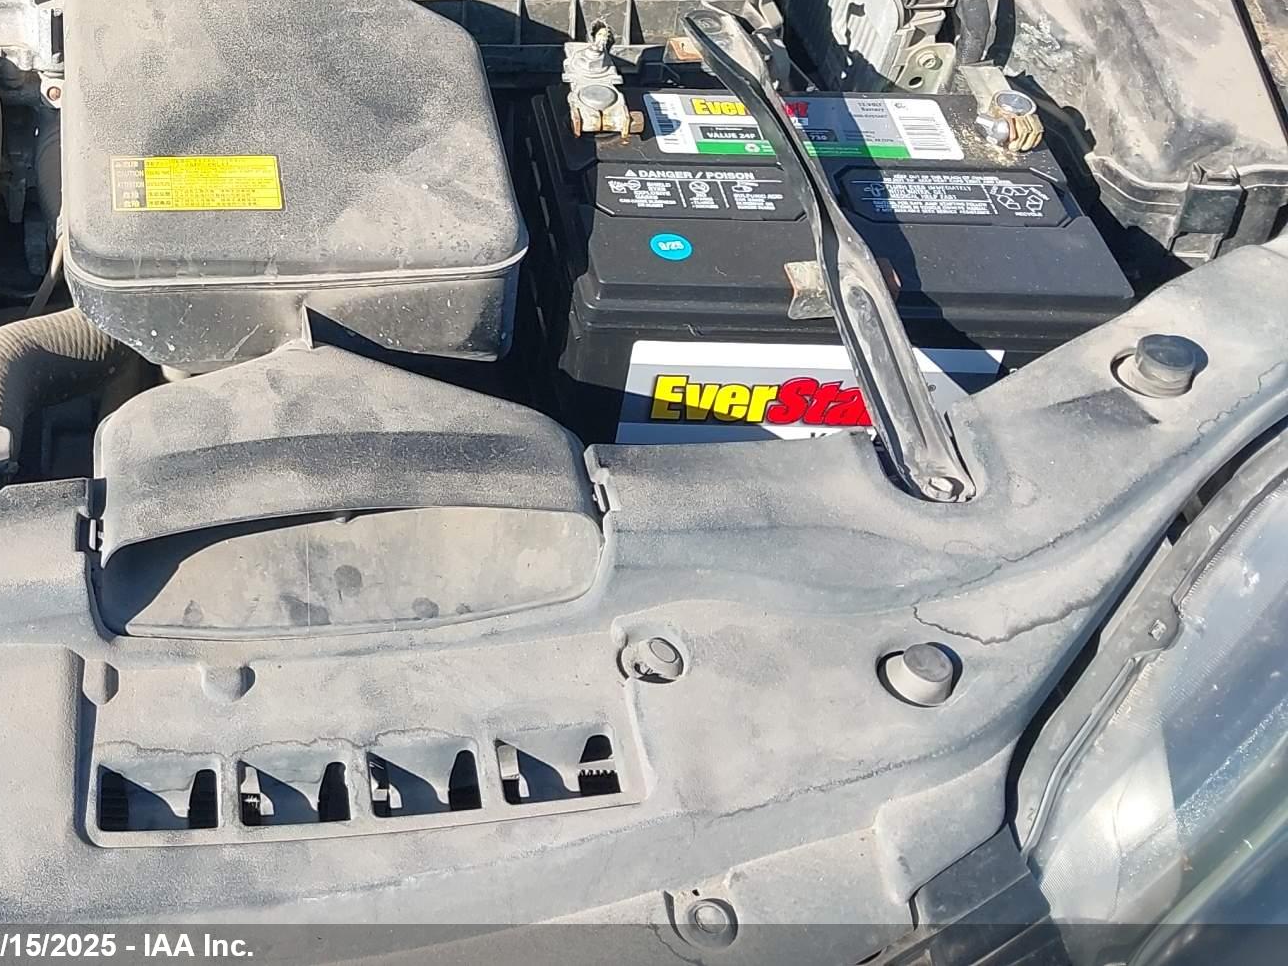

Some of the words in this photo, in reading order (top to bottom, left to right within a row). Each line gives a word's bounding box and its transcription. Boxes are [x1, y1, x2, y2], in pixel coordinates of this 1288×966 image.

[706, 131, 738, 139] VALUE
[637, 170, 693, 179] DANGER
[705, 171, 756, 180] POISON
